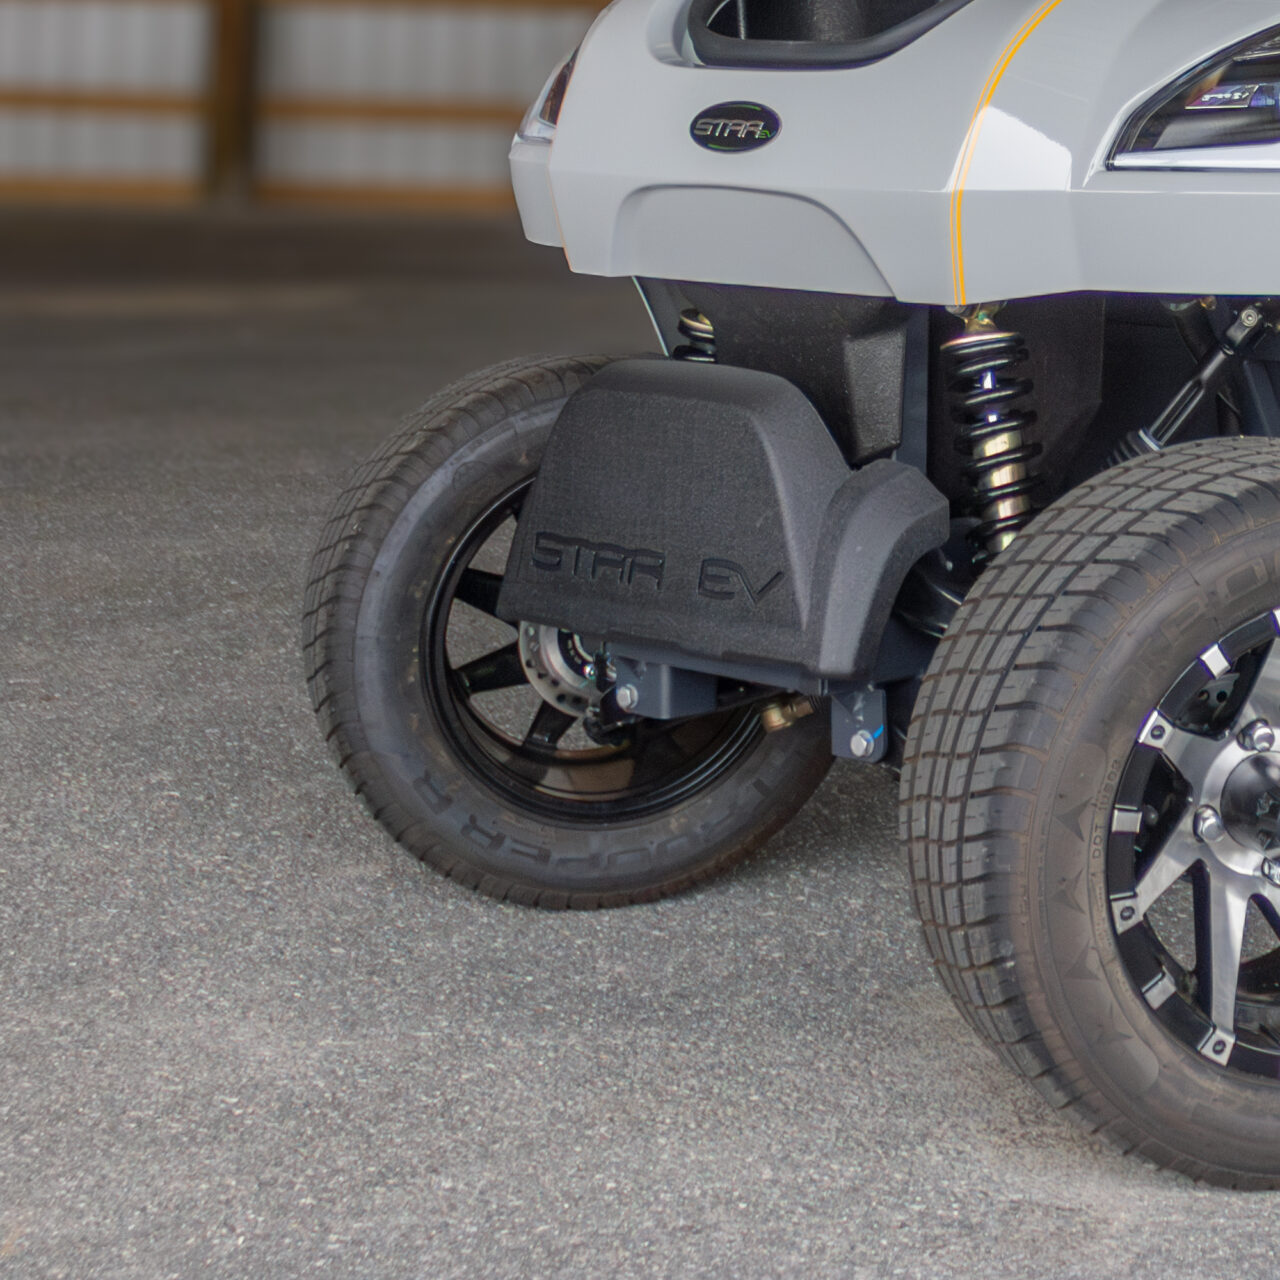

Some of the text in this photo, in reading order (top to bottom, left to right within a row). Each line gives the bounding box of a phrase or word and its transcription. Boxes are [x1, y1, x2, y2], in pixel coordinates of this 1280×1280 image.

[694, 118, 764, 138] STAR
[532, 531, 783, 604] STAR EV
